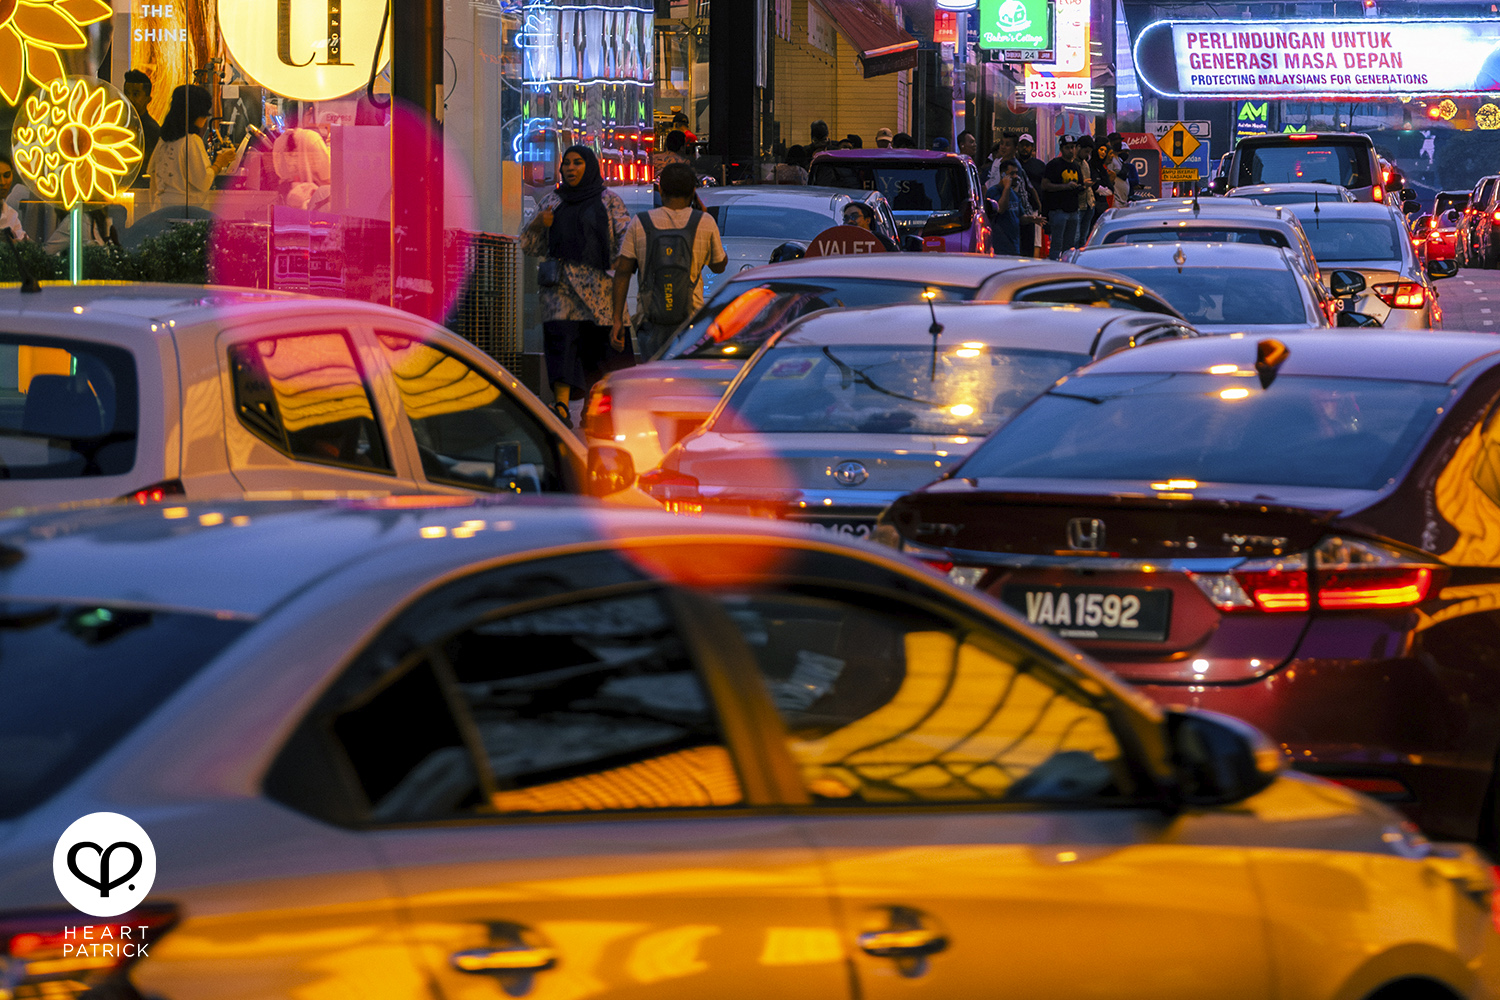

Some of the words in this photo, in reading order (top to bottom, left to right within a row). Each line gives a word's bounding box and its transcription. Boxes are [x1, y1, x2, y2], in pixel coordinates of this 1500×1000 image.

[142, 5, 173, 18] THE
[134, 28, 187, 42] SHINE
[1187, 31, 1325, 50] PERLINDUNGAN
[1332, 31, 1393, 49] UNTUK
[1190, 52, 1278, 70] GENERASI
[1285, 52, 1337, 69] MASA
[1344, 52, 1403, 69] DEPAN
[1191, 74, 1255, 85] PROTECTING
[1259, 74, 1327, 85] MALAYSIANS
[1331, 74, 1351, 84] FOR
[1355, 74, 1428, 85] GENERATIONS
